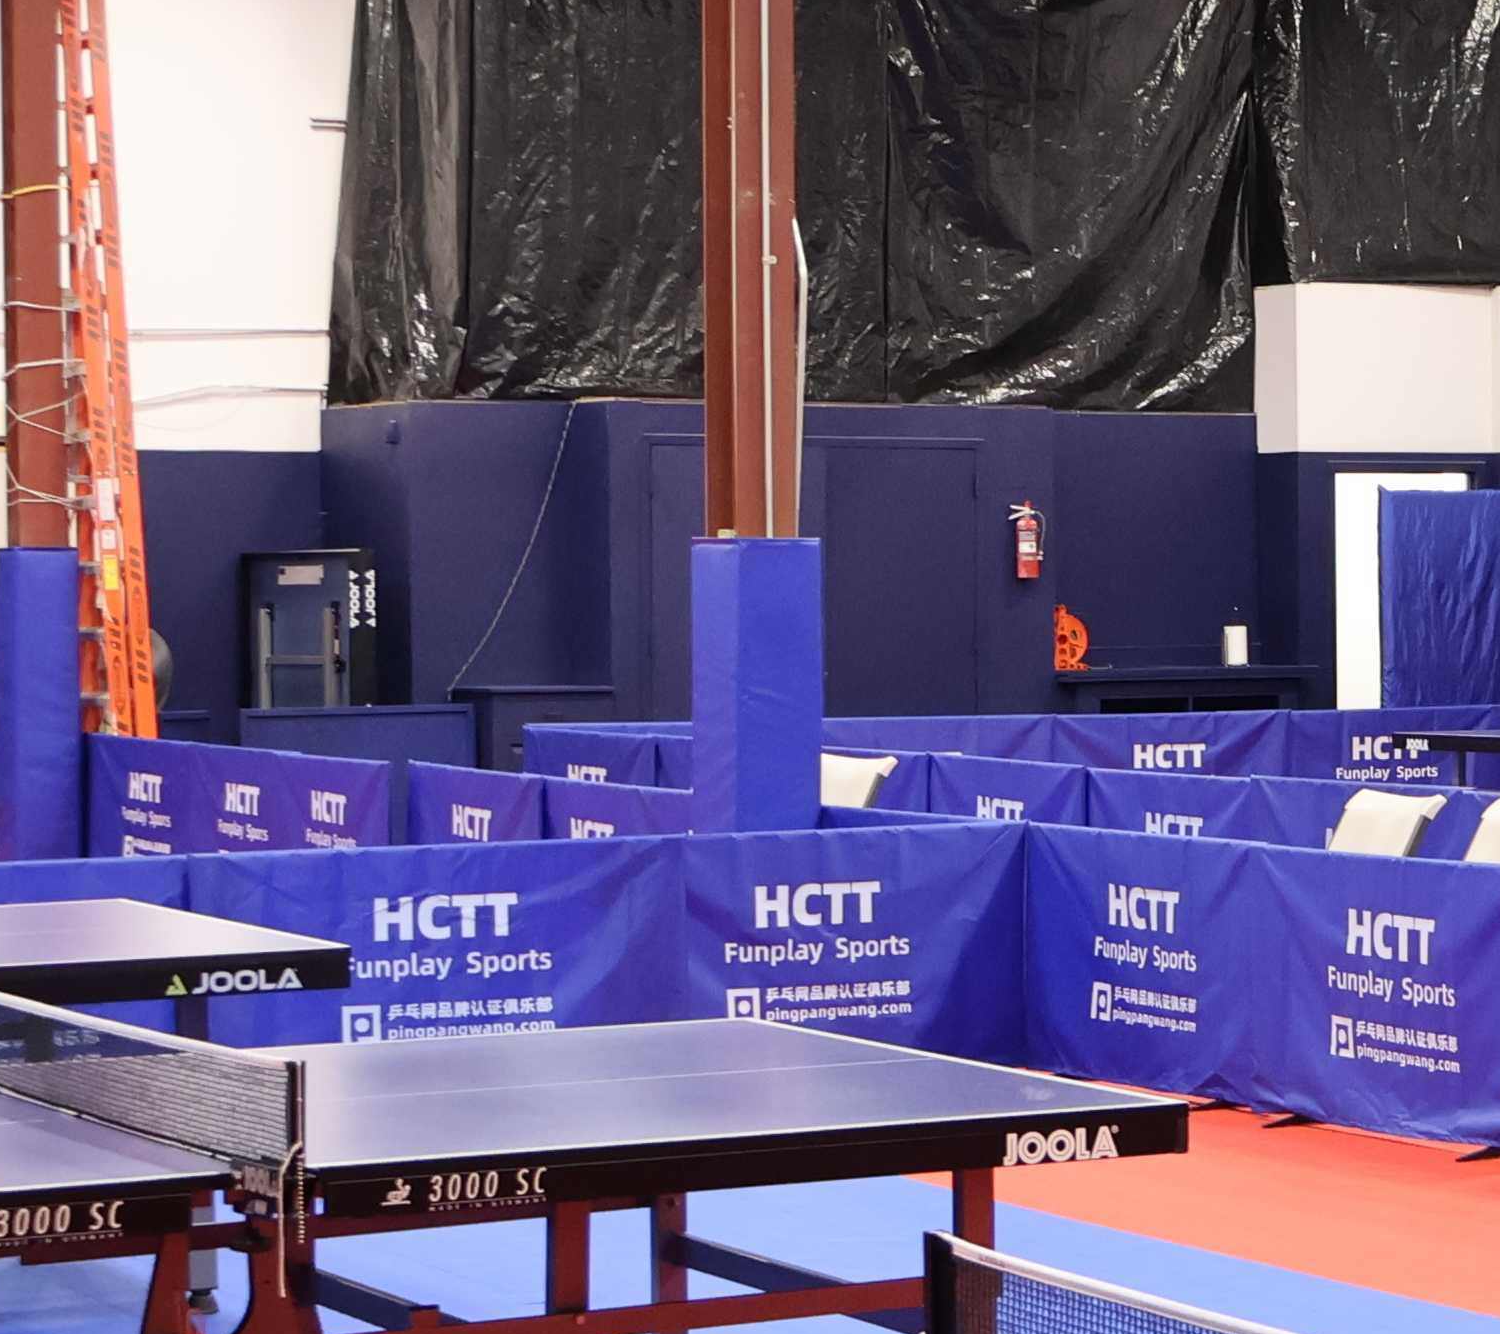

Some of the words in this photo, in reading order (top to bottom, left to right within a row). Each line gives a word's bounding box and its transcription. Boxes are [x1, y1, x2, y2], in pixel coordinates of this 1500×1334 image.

[1133, 743, 1206, 769] HCTT
[129, 771, 163, 804] HCTT
[225, 782, 261, 817] HCTT
[311, 789, 347, 826] HCTT
[452, 804, 492, 843] HCTT
[372, 892, 518, 942] HCTT
[754, 881, 881, 929] HCTT
[1108, 883, 1180, 934] HCTT
[725, 938, 824, 966] Funplay
[835, 935, 910, 962] Sports
[1094, 936, 1148, 969] Funplay
[1153, 945, 1197, 972] Sports
[1346, 907, 1435, 965] HCTT
[190, 967, 304, 995] JOOLA
[1328, 965, 1394, 1003] Funplay
[1402, 976, 1457, 1008] Sports
[1356, 1043, 1461, 1073] pingpangwang.com
[1003, 1125, 1119, 1166] JOOLA
[428, 1170, 499, 1203] 3000
[516, 1166, 548, 1195] SC
[88, 1200, 124, 1230] SC
